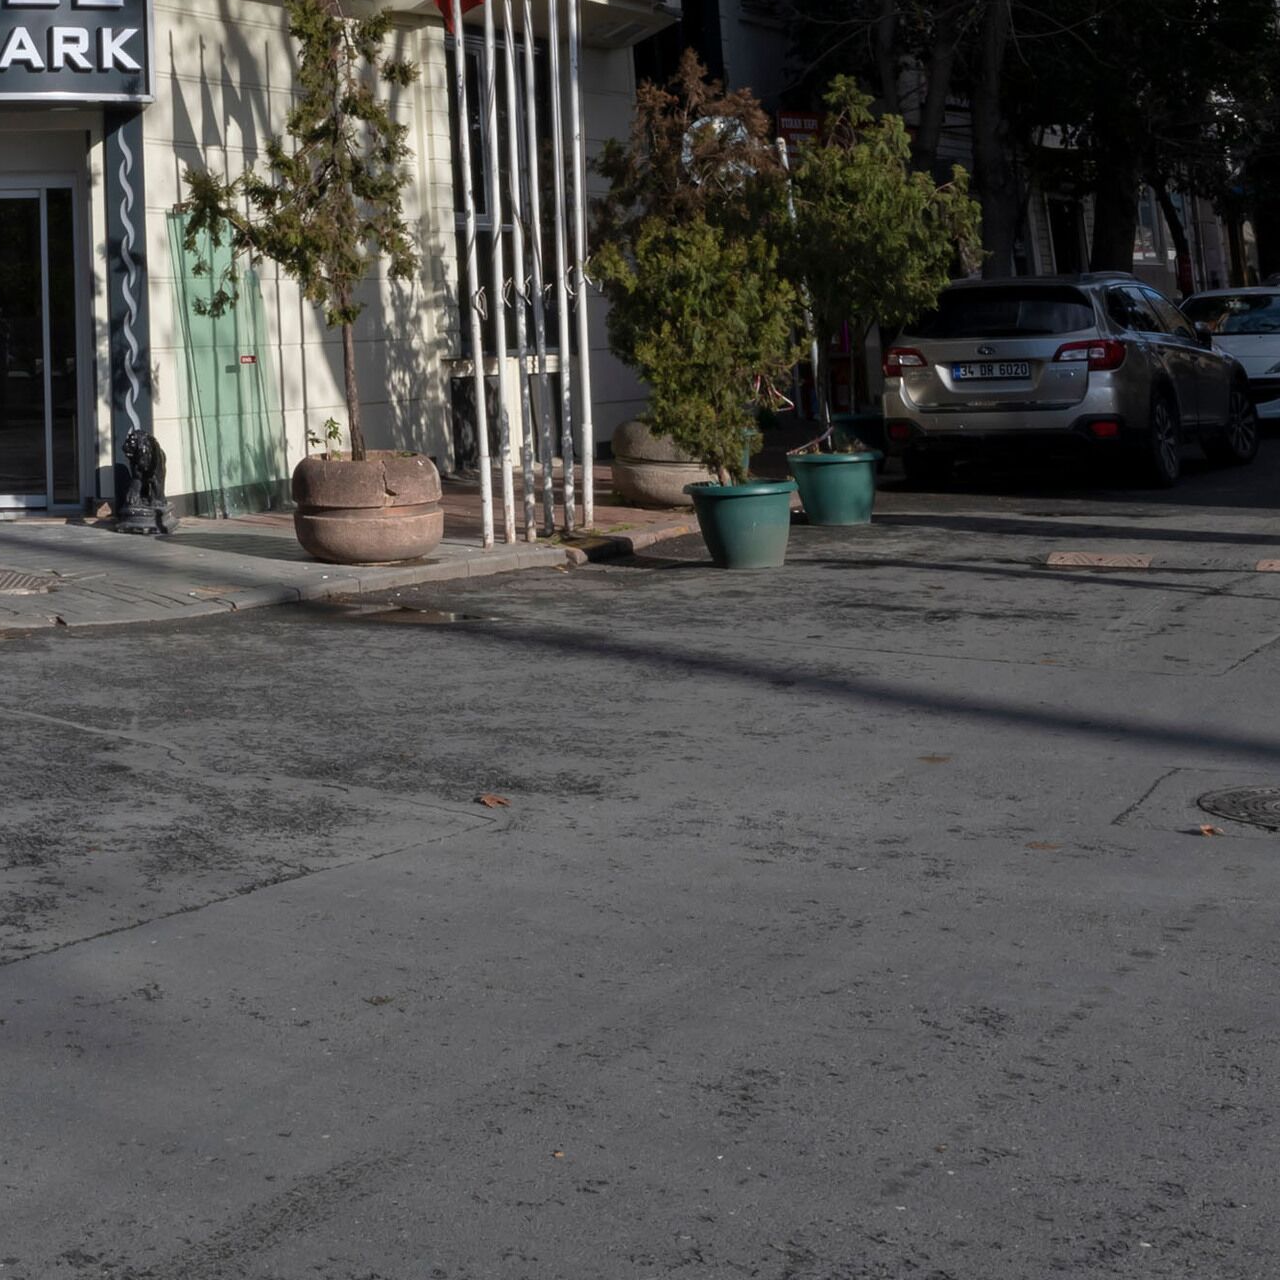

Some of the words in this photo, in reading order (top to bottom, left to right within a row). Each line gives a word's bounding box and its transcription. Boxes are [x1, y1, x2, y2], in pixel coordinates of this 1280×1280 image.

[961, 364, 974, 377] 34
[980, 363, 994, 376] DR
[999, 362, 1028, 376] 6020
